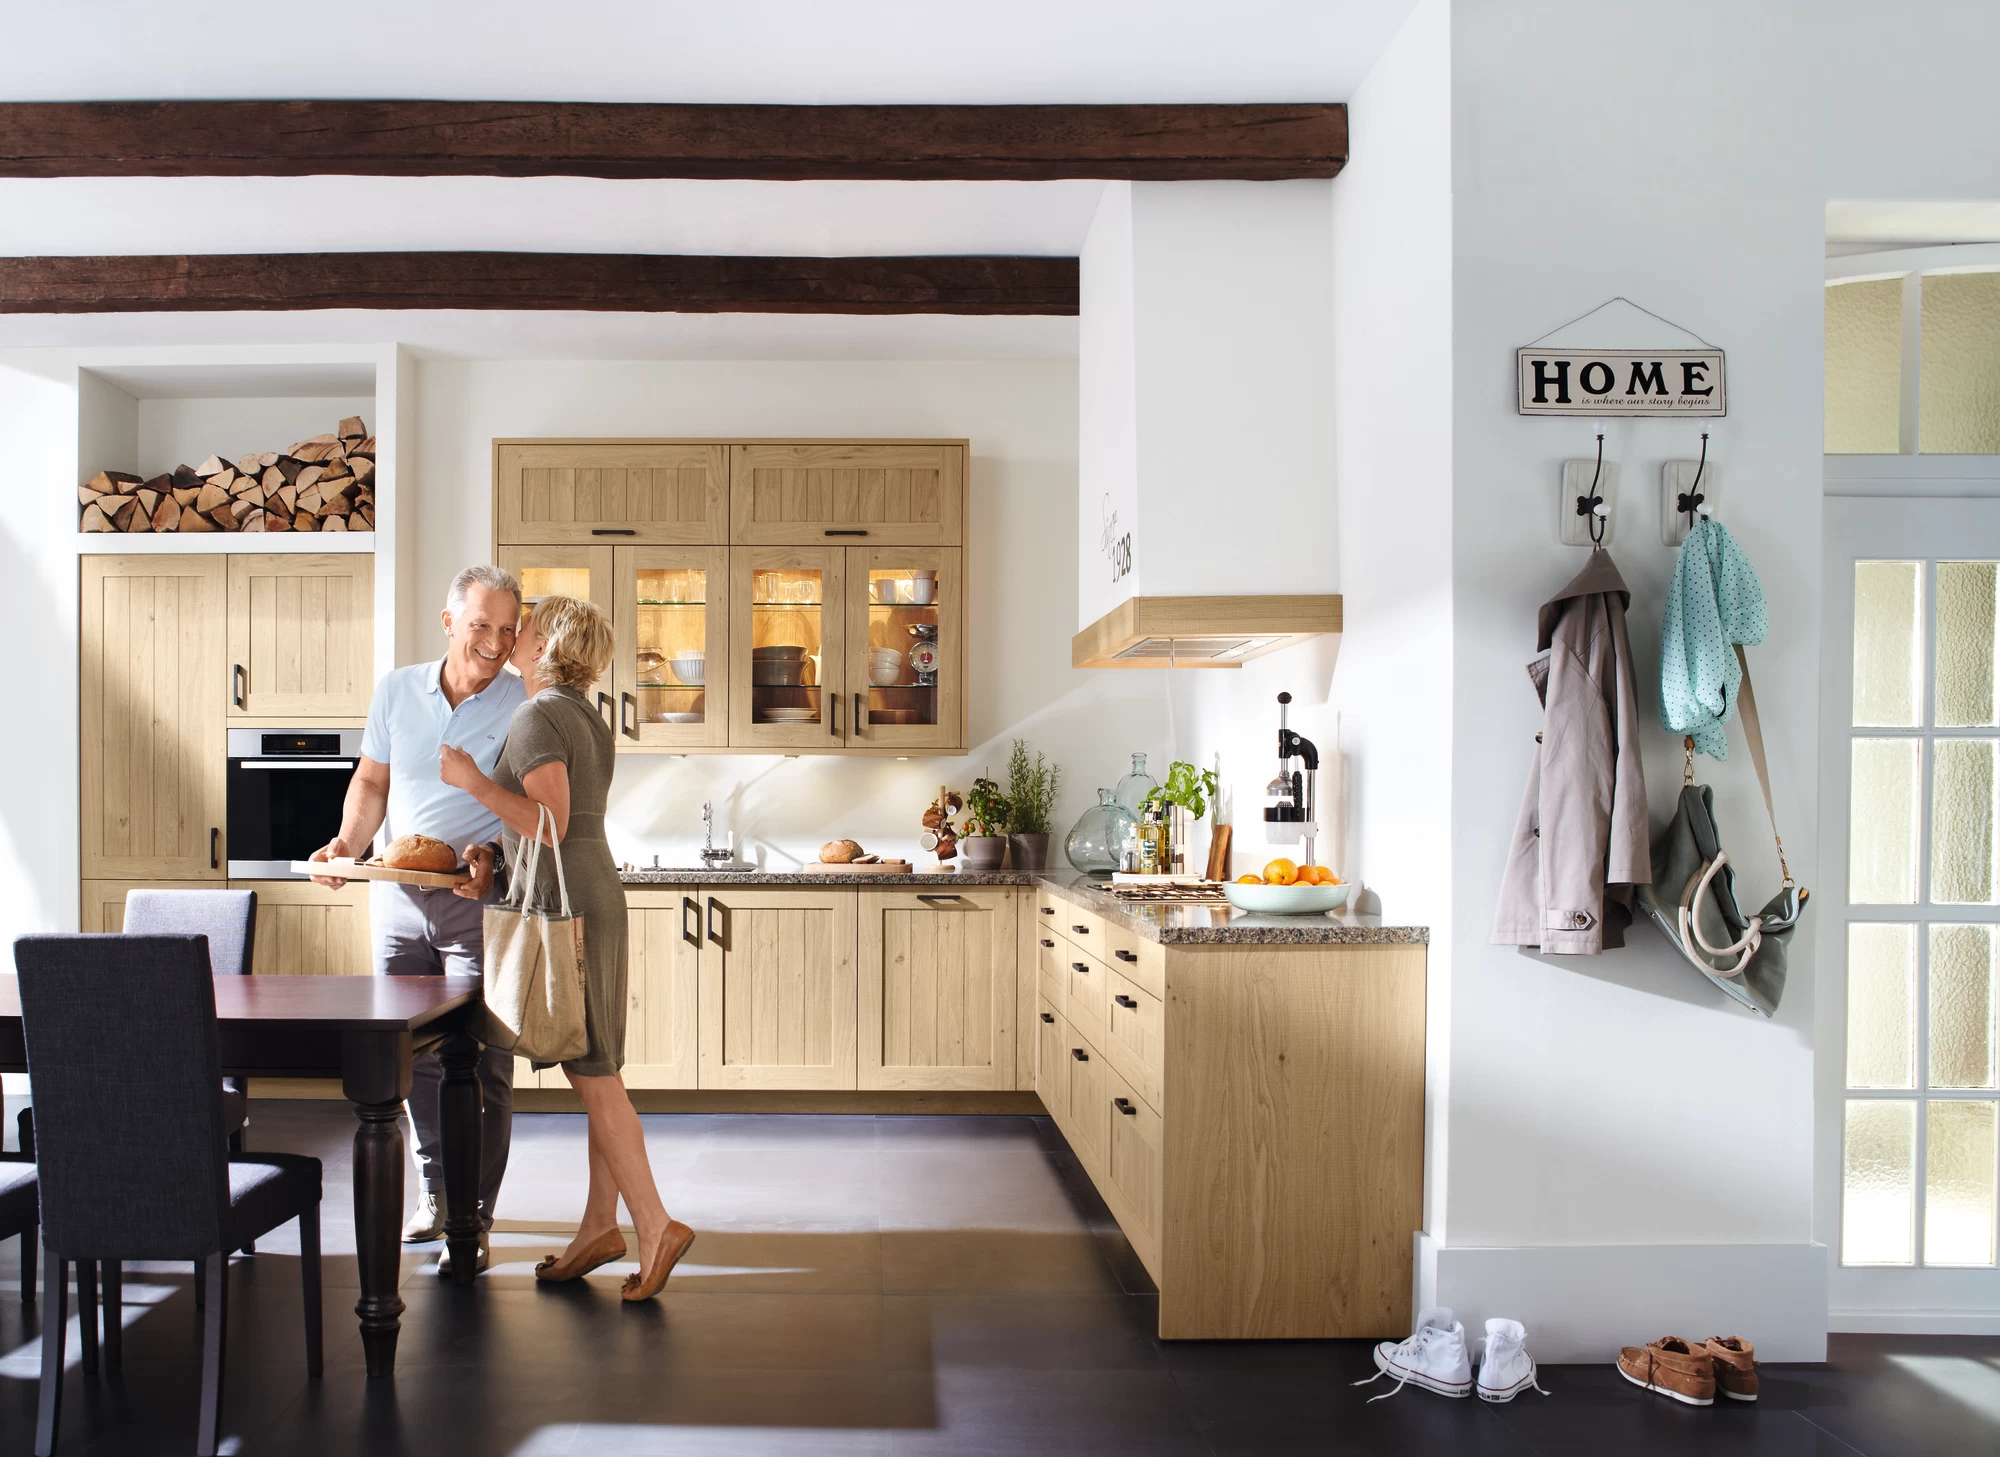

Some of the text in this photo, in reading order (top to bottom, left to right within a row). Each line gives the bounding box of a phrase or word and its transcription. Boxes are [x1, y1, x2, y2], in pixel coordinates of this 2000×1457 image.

[1531, 360, 1714, 403] HOME
[1581, 396, 1591, 405] is
[1593, 395, 1625, 405] where
[1648, 398, 1674, 408] story
[1678, 395, 1711, 408] begins
[1112, 532, 1132, 583] 1928
